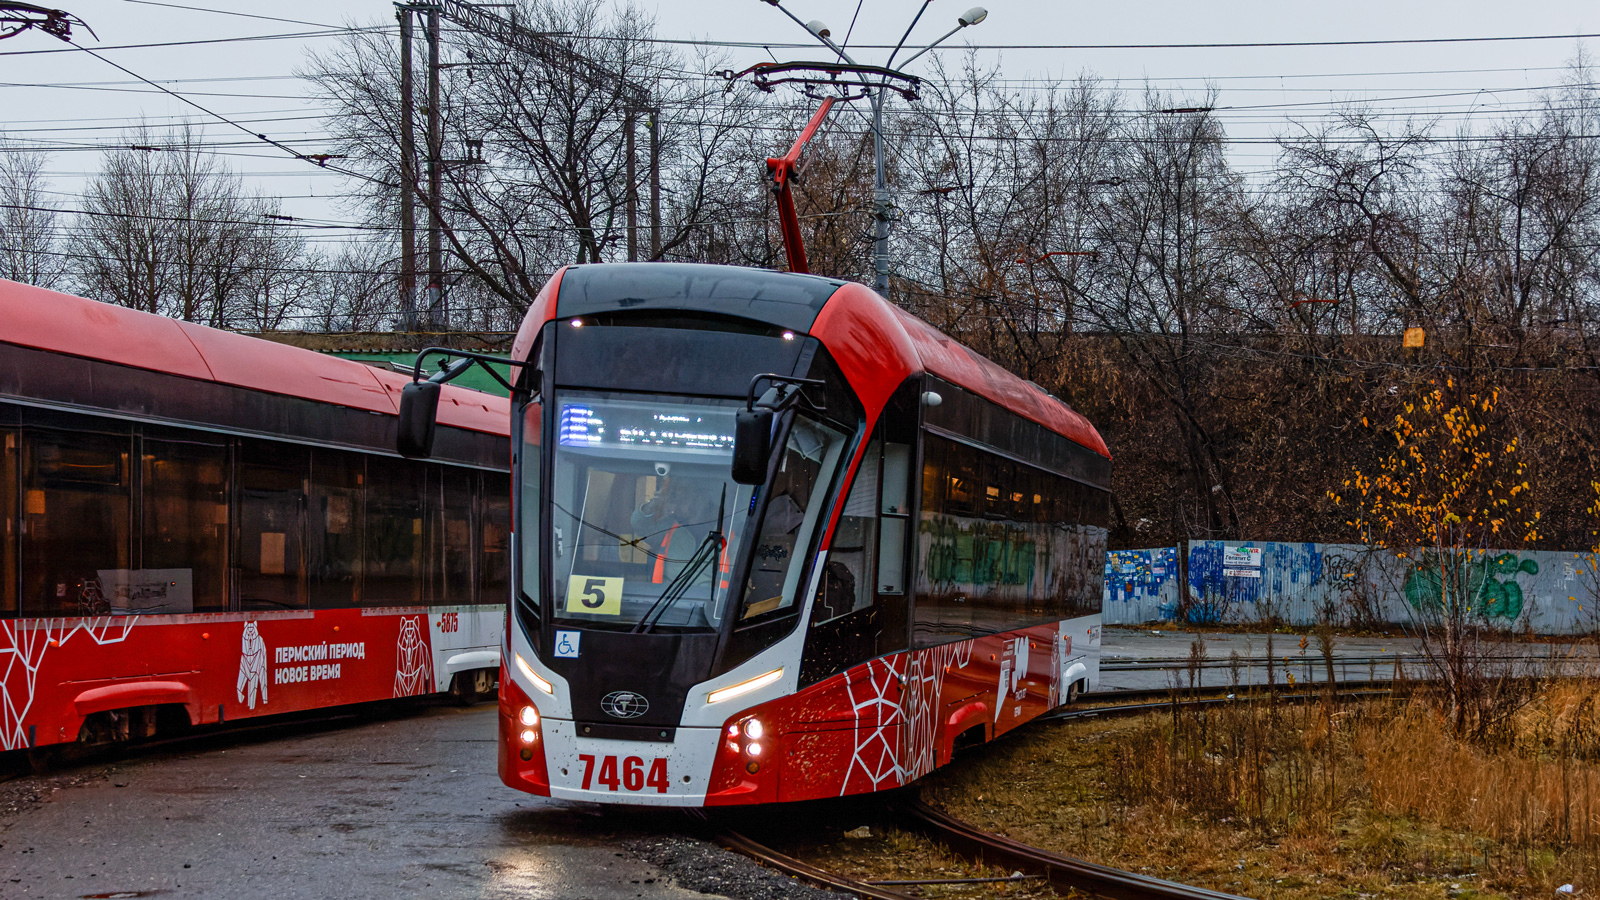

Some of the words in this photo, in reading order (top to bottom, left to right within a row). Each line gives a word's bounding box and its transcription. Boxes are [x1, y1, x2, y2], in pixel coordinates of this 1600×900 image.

[581, 578, 606, 608] 5
[441, 612, 459, 633] 5875
[275, 641, 328, 664] ПЕРМСКИЙ
[329, 642, 365, 660] ПЕРИОД
[275, 665, 309, 685] НОВОЕ
[310, 663, 341, 681] ВРЕМЯ
[579, 754, 670, 794] 7464
